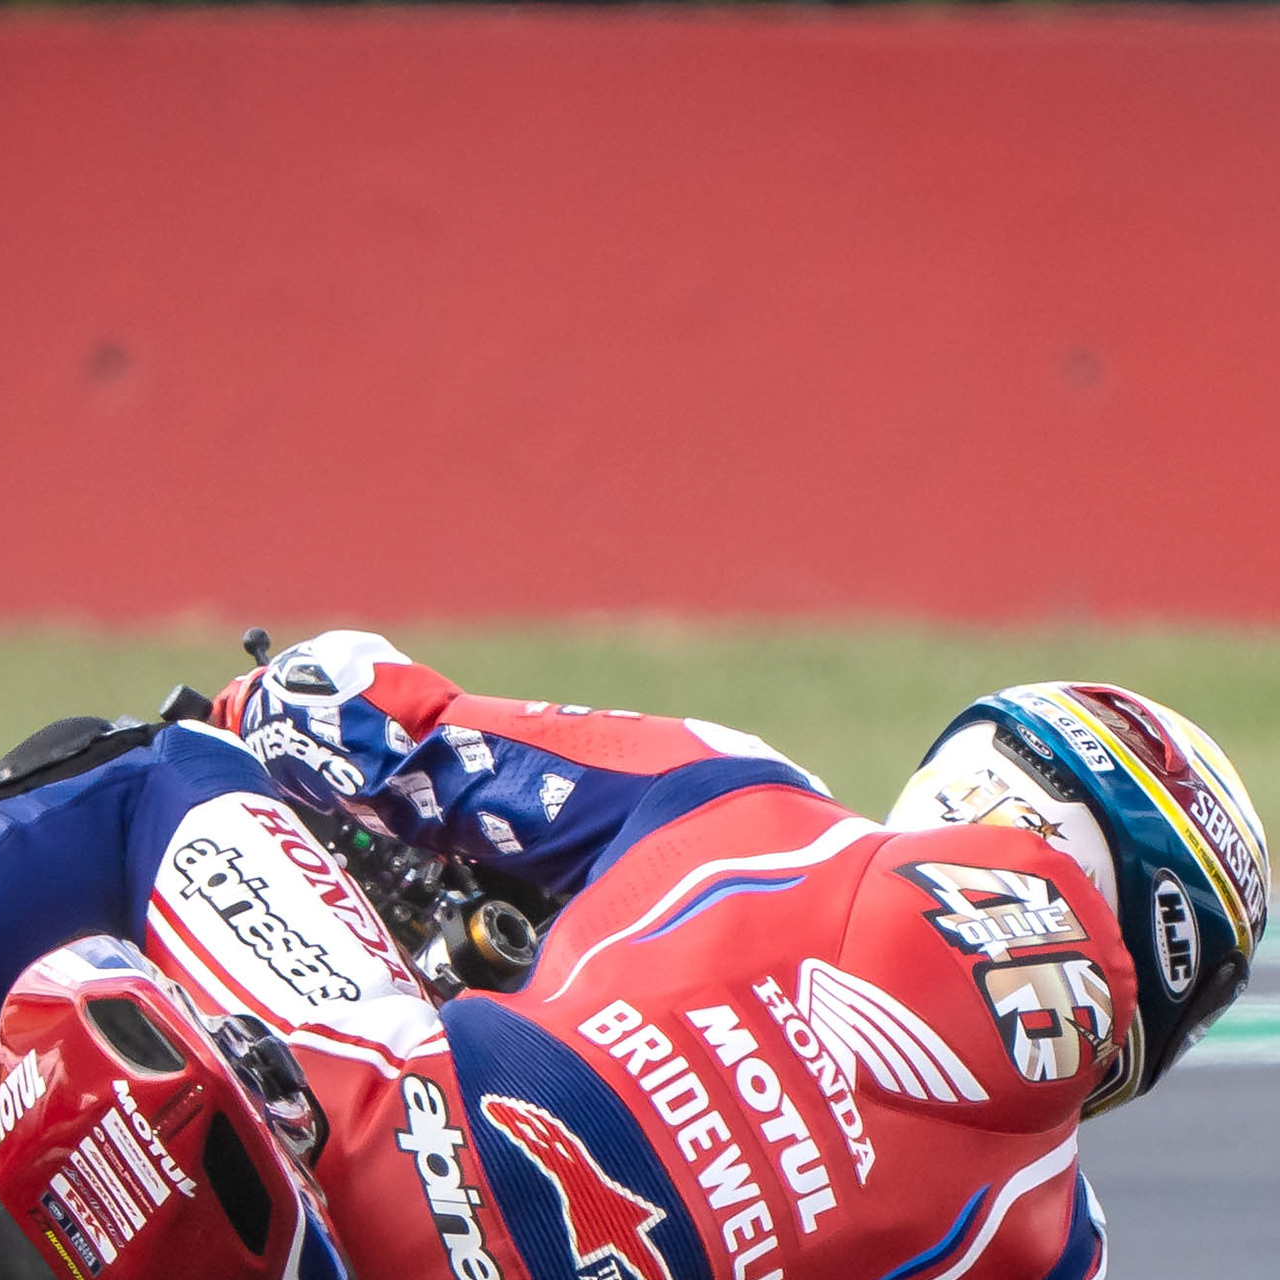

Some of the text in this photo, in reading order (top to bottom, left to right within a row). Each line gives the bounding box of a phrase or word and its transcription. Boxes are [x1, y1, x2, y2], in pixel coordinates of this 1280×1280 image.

[173, 837, 362, 1007] alpinestars
[240, 802, 412, 984] HONDA
[892, 860, 1116, 1084] 46
[954, 905, 1073, 945] OLLIE
[1156, 892, 1192, 982] HJC
[112, 1079, 199, 1199] MOTUL
[685, 1003, 838, 1235] MOTUL
[752, 975, 877, 1188] HONDA
[64, 1187, 104, 1244] RK
